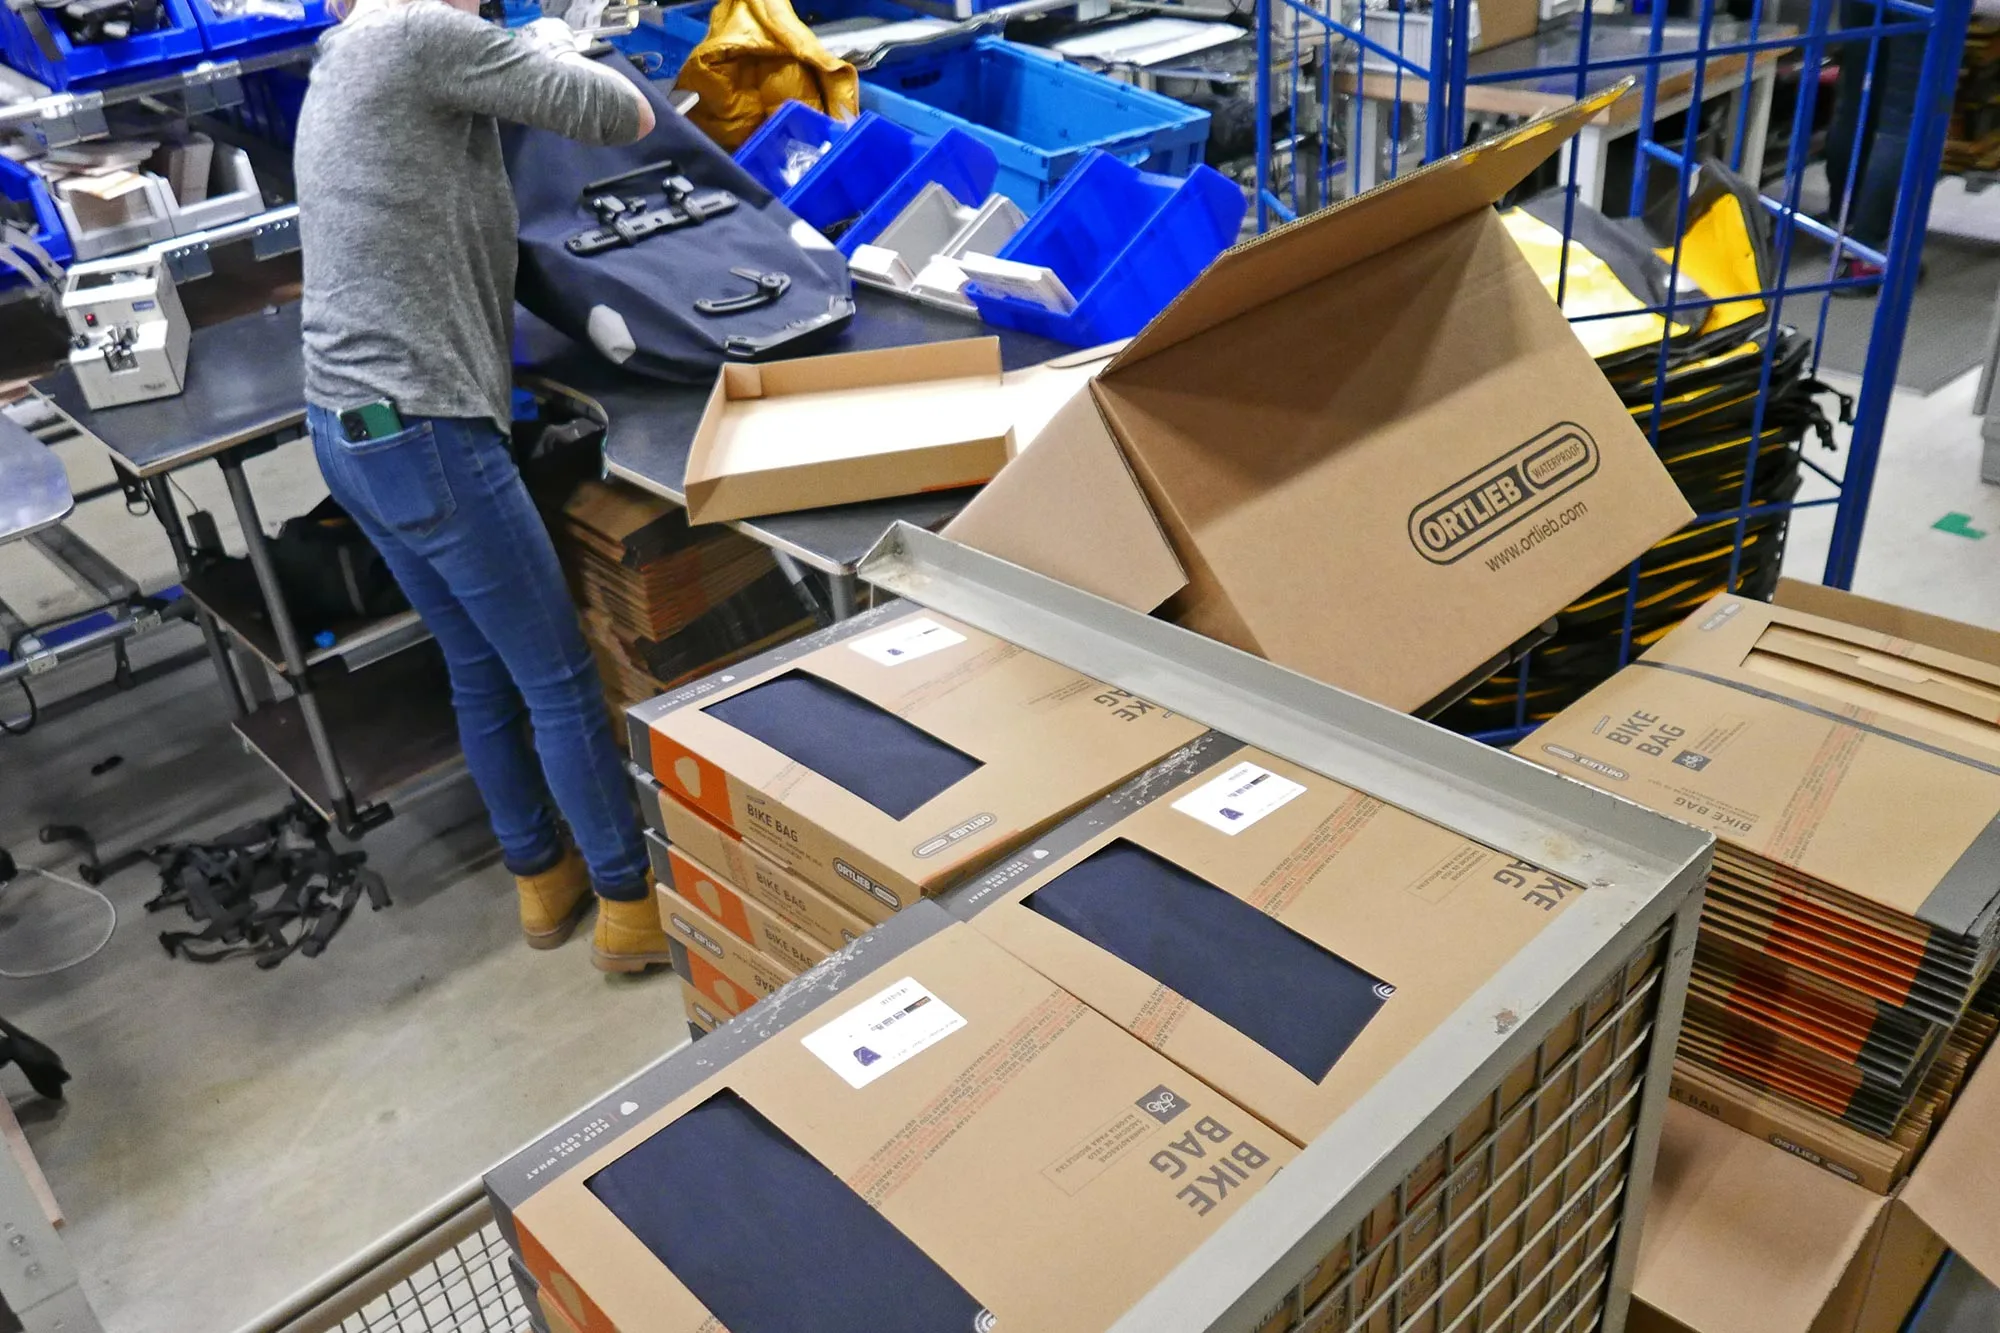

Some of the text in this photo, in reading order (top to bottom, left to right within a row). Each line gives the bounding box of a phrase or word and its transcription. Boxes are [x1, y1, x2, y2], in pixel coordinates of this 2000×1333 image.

[1423, 443, 1581, 548] ORTLIEB WATERPROOF
[1485, 500, 1589, 573] www.ortlieb.com
[1606, 710, 1660, 748] BIKE
[1635, 723, 1685, 756] BAG
[1578, 757, 1624, 778] ORTLIEB
[747, 803, 772, 827] BIKE
[774, 819, 798, 842] BAG
[1672, 795, 1709, 815] BAG
[1711, 810, 1752, 832] BIKE
[948, 814, 991, 839] ORTLIEB
[756, 871, 780, 895] BIKE
[784, 889, 805, 912] BAG
[837, 862, 871, 890] ORTLIEB
[582, 1117, 604, 1133] YOU
[525, 1122, 609, 1180] KEEP DRY WHAT
[1148, 1115, 1233, 1180] BAG
[1175, 1140, 1270, 1217] BIKE
